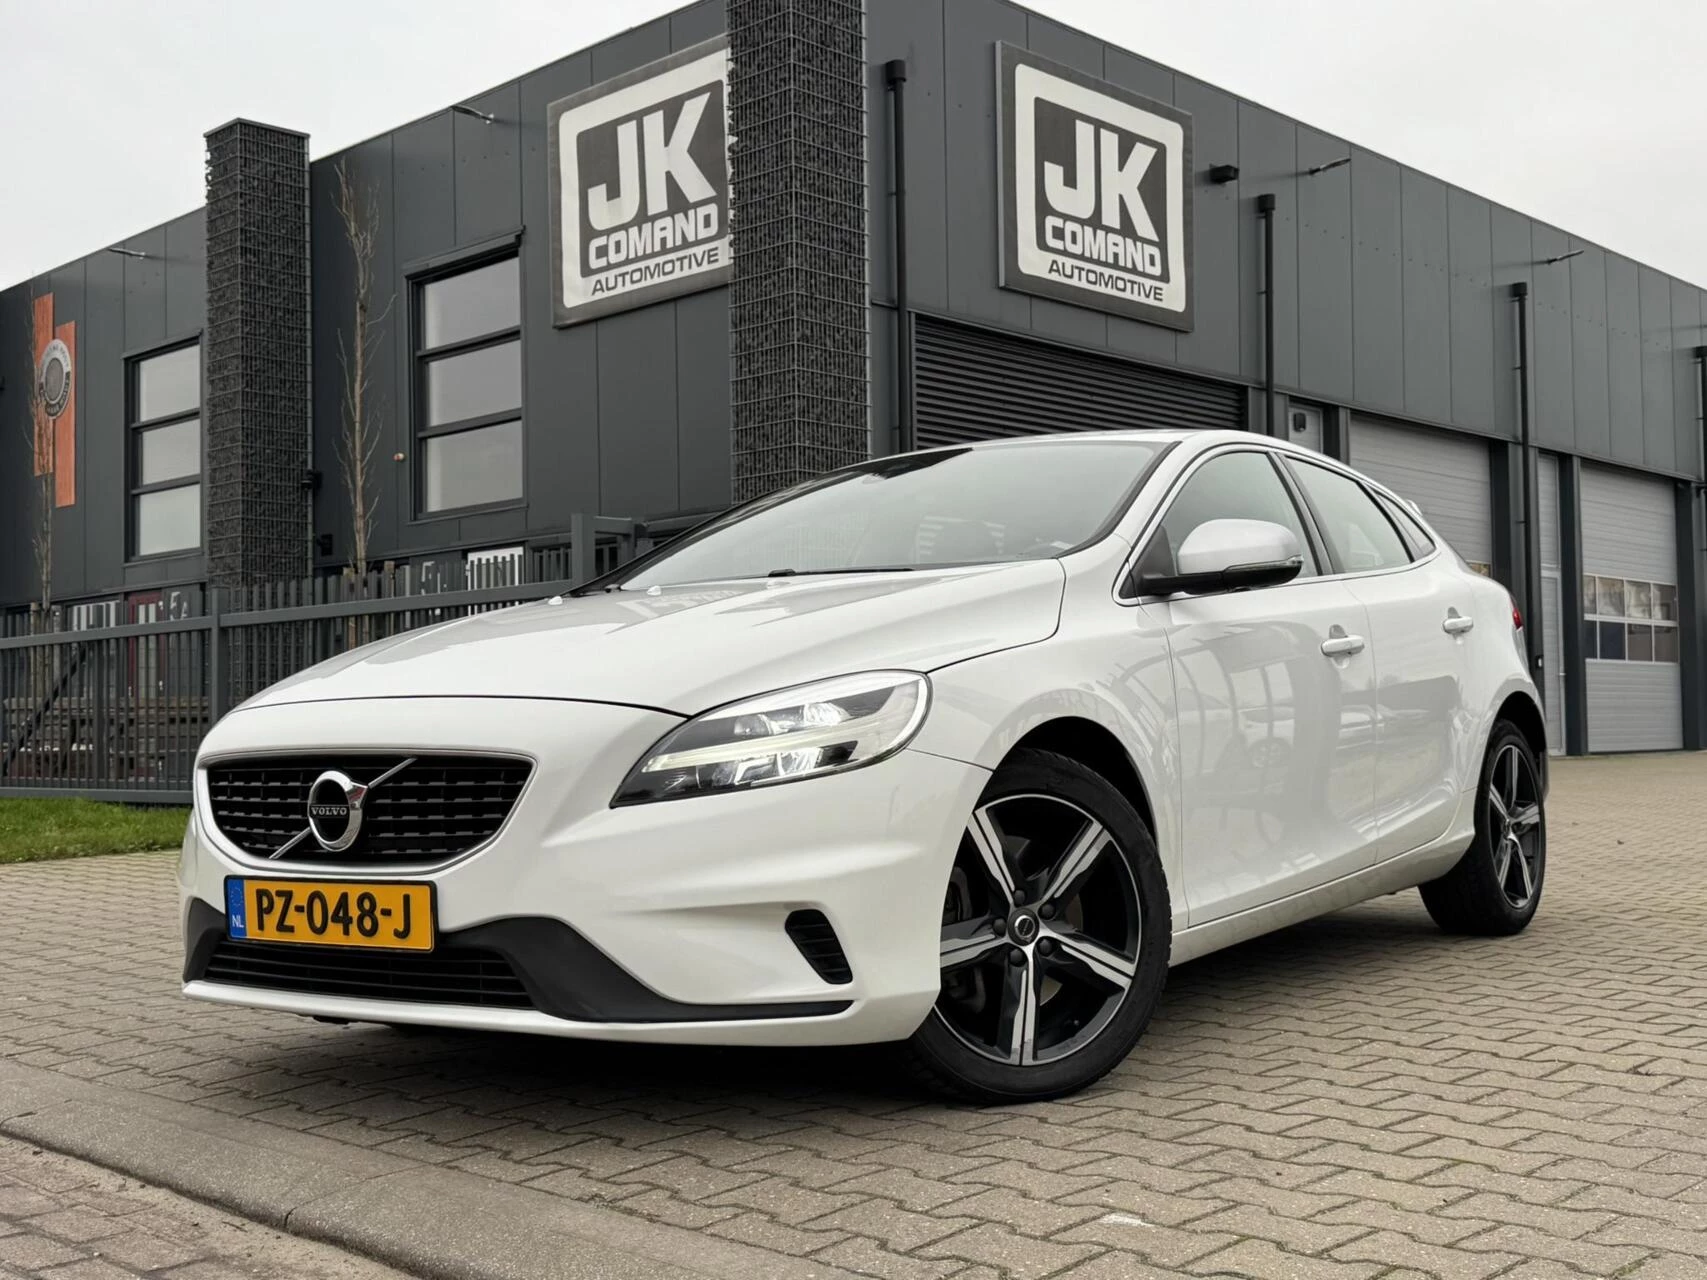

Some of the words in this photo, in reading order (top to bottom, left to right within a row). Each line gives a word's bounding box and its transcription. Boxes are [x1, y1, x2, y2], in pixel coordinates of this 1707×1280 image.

[587, 92, 718, 231] JK
[1044, 119, 1160, 242] JK
[588, 203, 719, 270] COMAND
[1045, 215, 1162, 277] COMAND
[591, 246, 720, 297] AUTOMOTIVE
[1048, 259, 1164, 302] AUTOMOTIVE
[310, 806, 348, 817] VOLVO
[231, 914, 244, 928] NL
[255, 888, 411, 940] PZ-048-J
